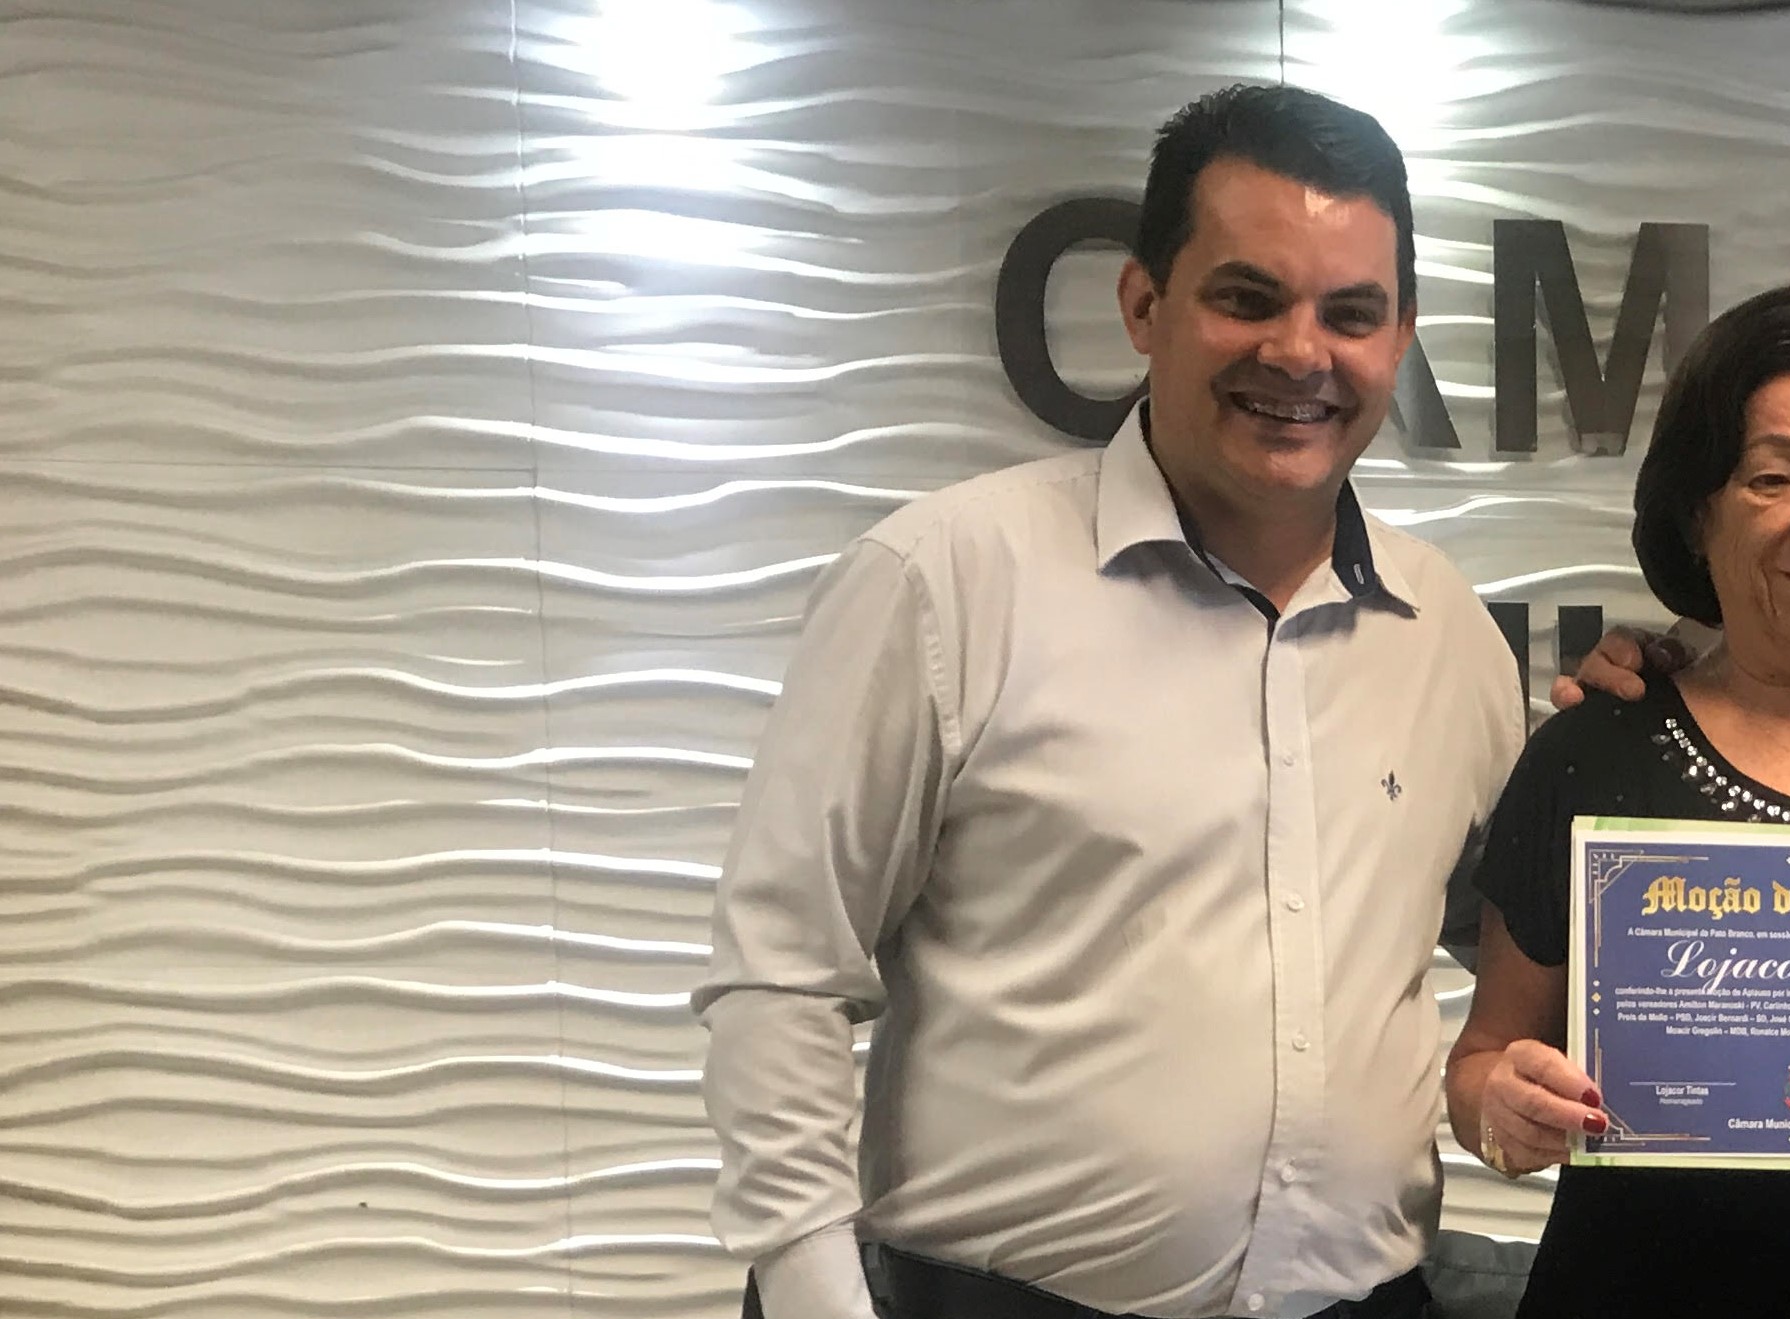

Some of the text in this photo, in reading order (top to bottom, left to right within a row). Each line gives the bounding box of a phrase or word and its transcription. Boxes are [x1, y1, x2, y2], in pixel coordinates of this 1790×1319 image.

[1642, 875, 1762, 921] Moção
[1655, 1085, 1709, 1097] Lojacor Tintas
[1728, 1118, 1763, 1130] Câmara
